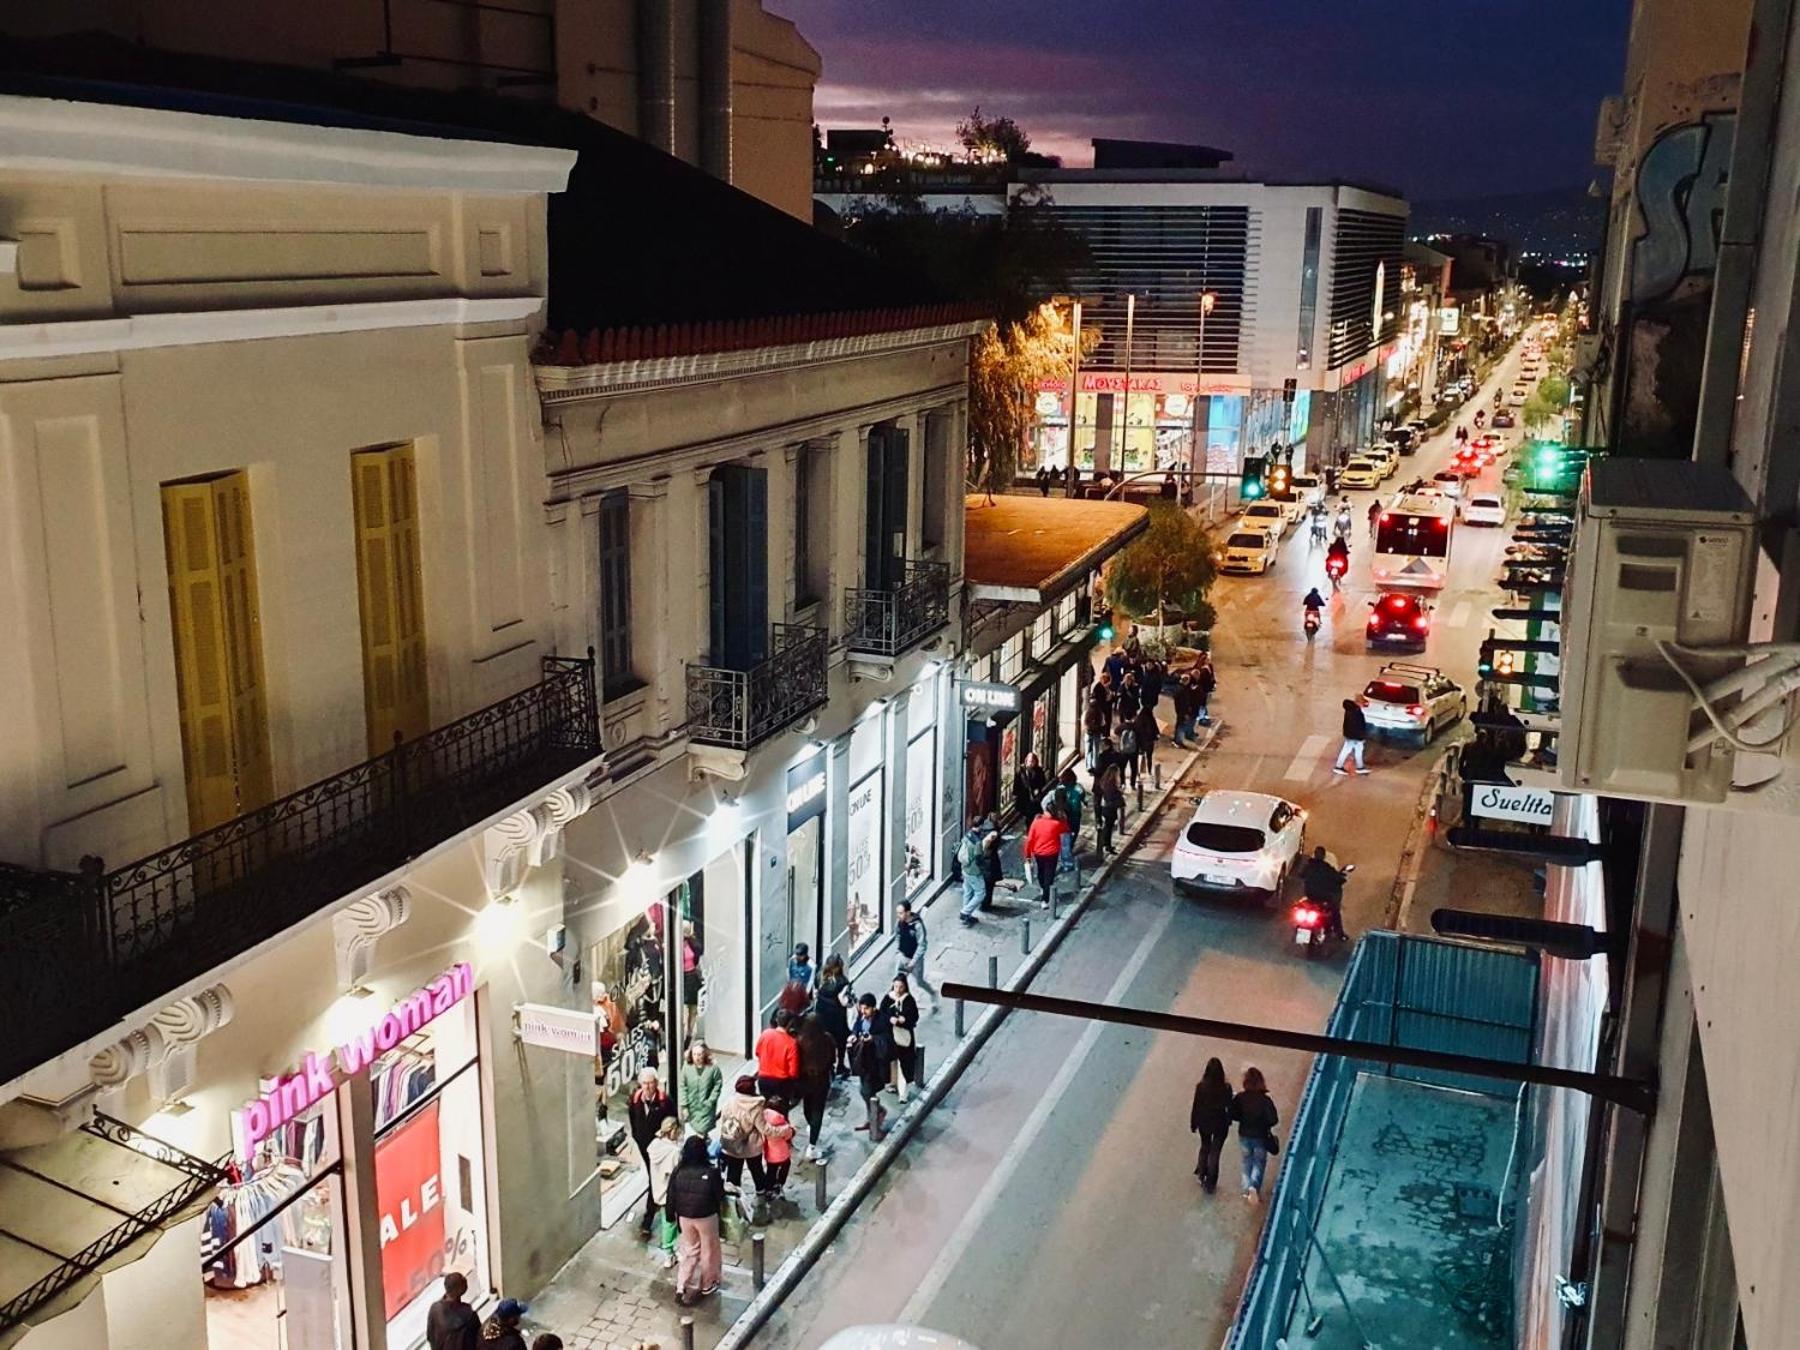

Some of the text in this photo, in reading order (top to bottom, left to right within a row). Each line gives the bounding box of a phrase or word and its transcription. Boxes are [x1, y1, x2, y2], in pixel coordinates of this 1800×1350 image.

[965, 688, 1015, 707] ON LINE
[241, 961, 475, 1161] pink woman
[611, 1022, 644, 1061] SALES
[380, 1173, 440, 1250] ALE
